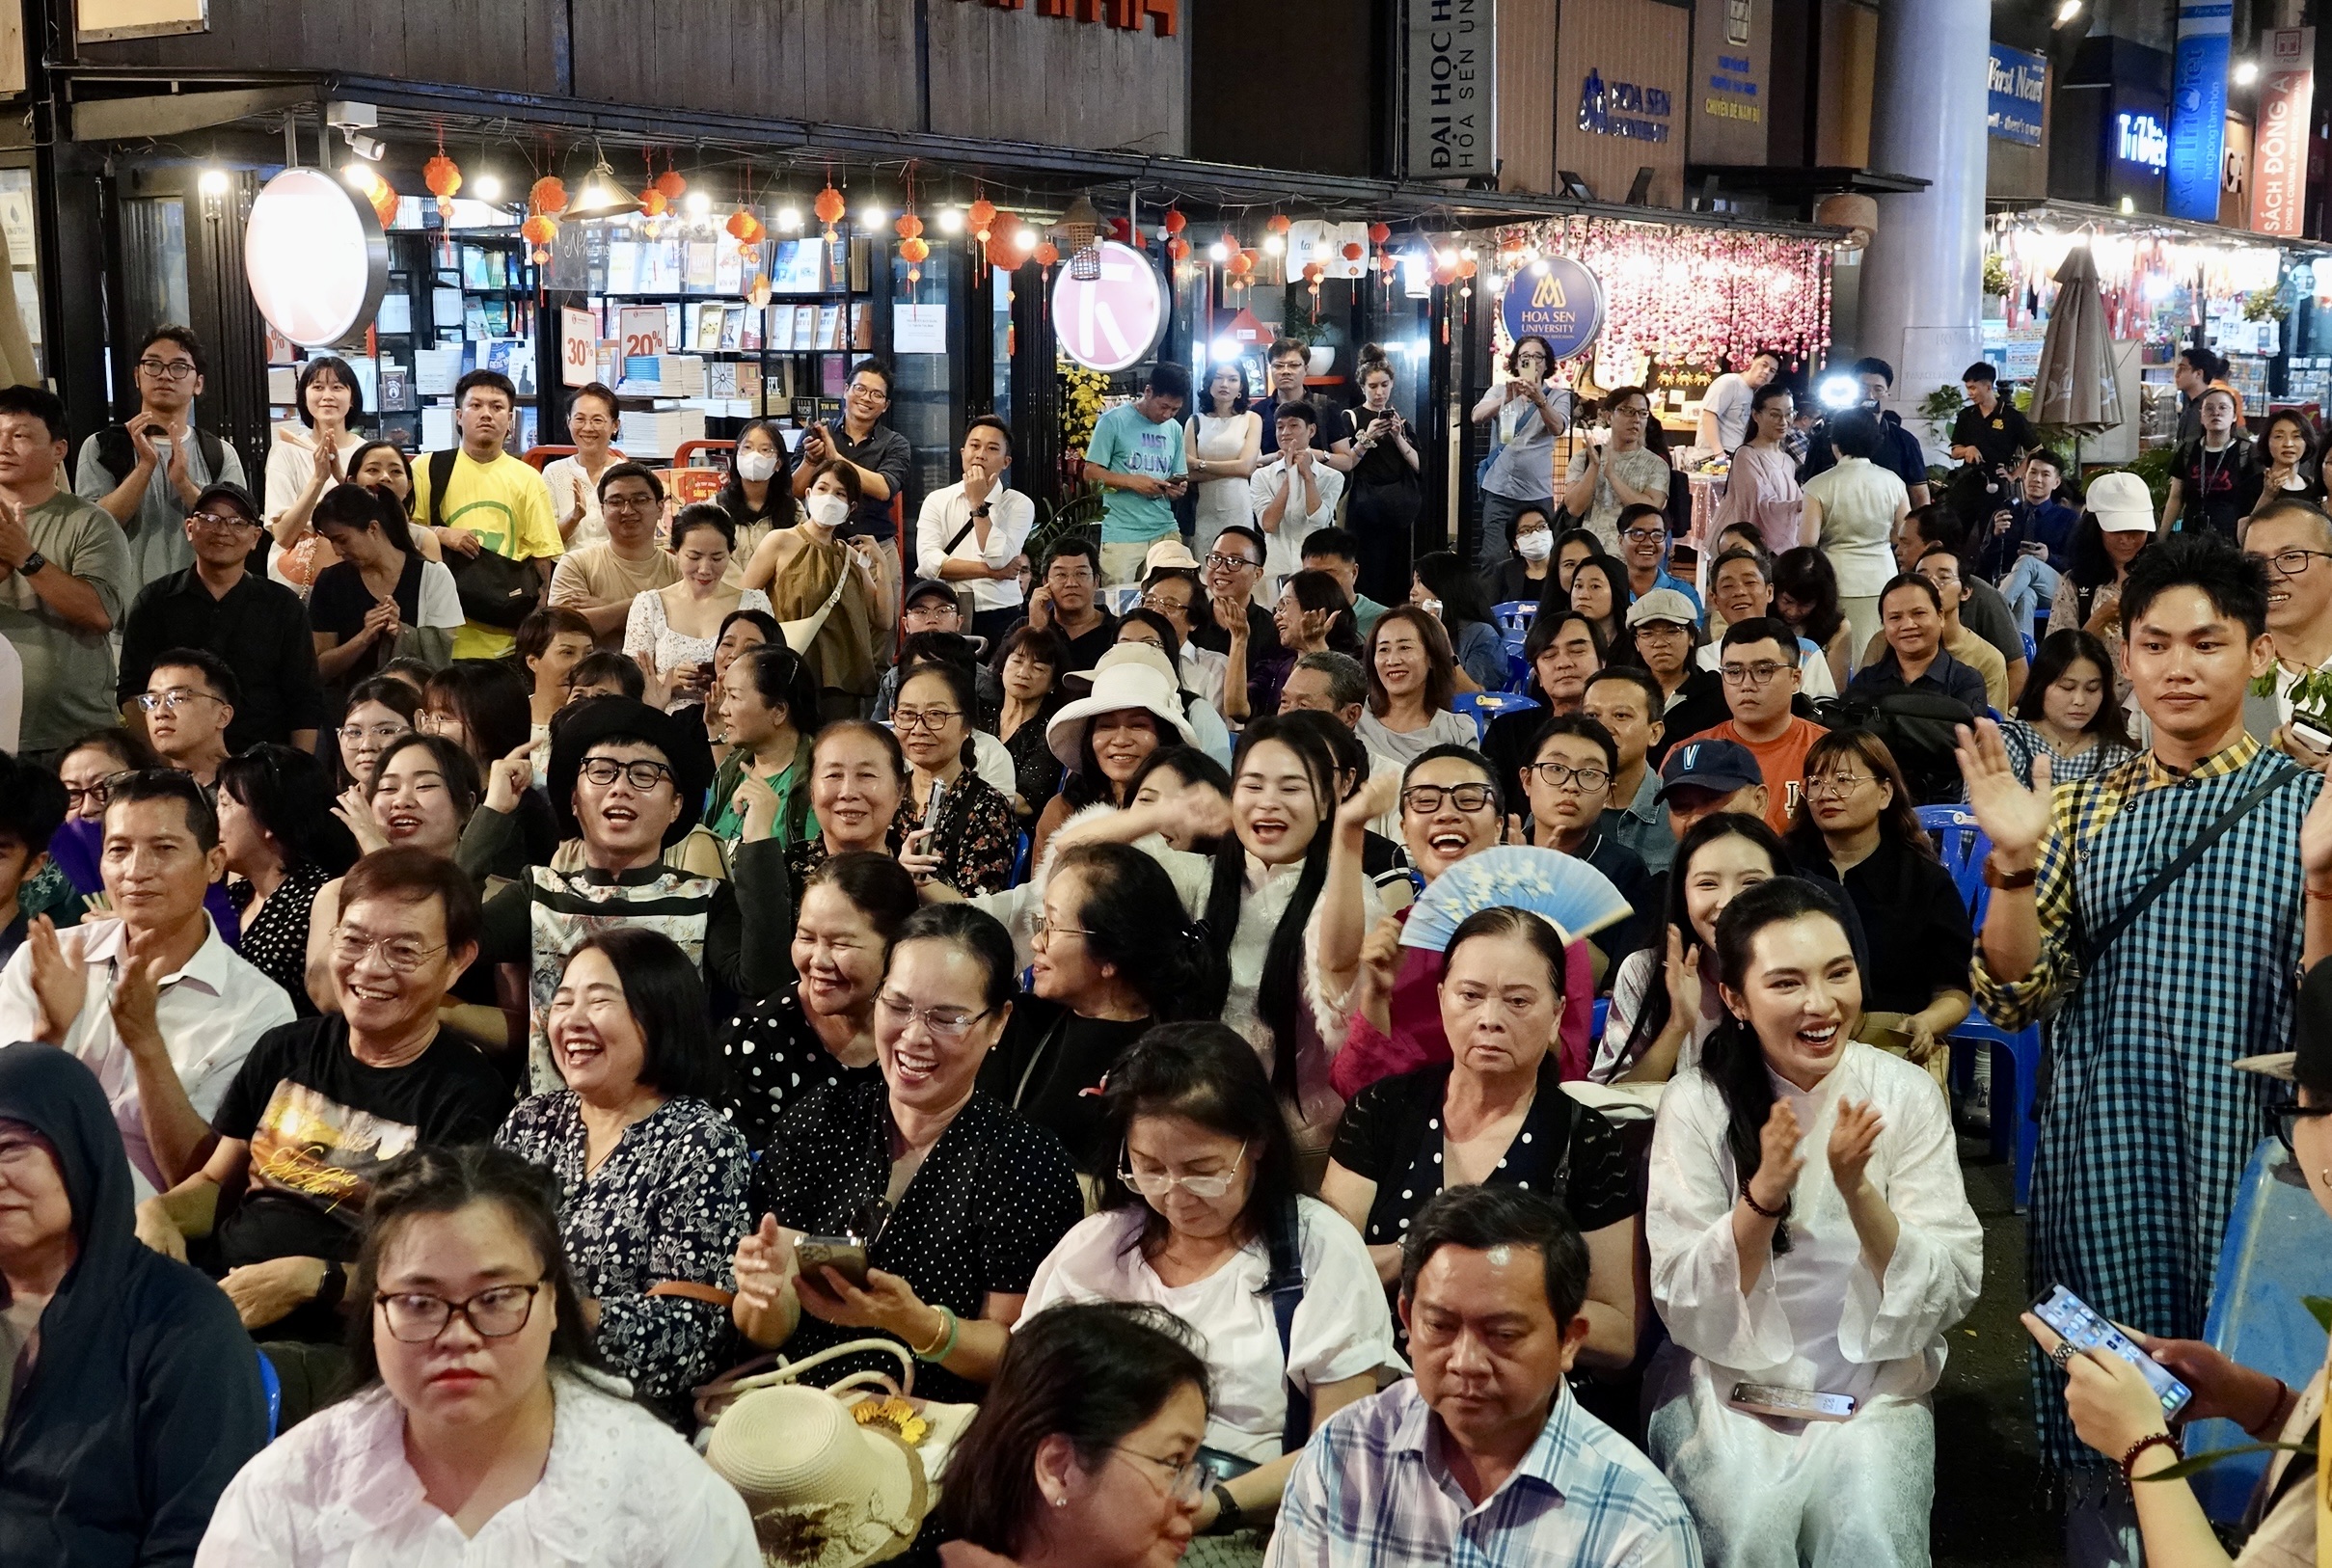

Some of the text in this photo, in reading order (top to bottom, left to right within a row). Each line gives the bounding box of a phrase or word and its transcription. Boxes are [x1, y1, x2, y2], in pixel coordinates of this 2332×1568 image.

[1430, 32, 1457, 106] HỌC
[1459, 50, 1475, 99] SEN
[1430, 117, 1457, 170] ĐẠI
[1459, 114, 1475, 168] HOA
[2261, 75, 2290, 231] SÁCH ĐÔNG A
[2283, 206, 2294, 231] DONG
[1521, 311, 1576, 323] HOA SEN
[1521, 323, 1575, 333] UNIVERSITY
[567, 338, 594, 366] 30%
[627, 330, 663, 357] 20%
[1142, 432, 1166, 450] JUST
